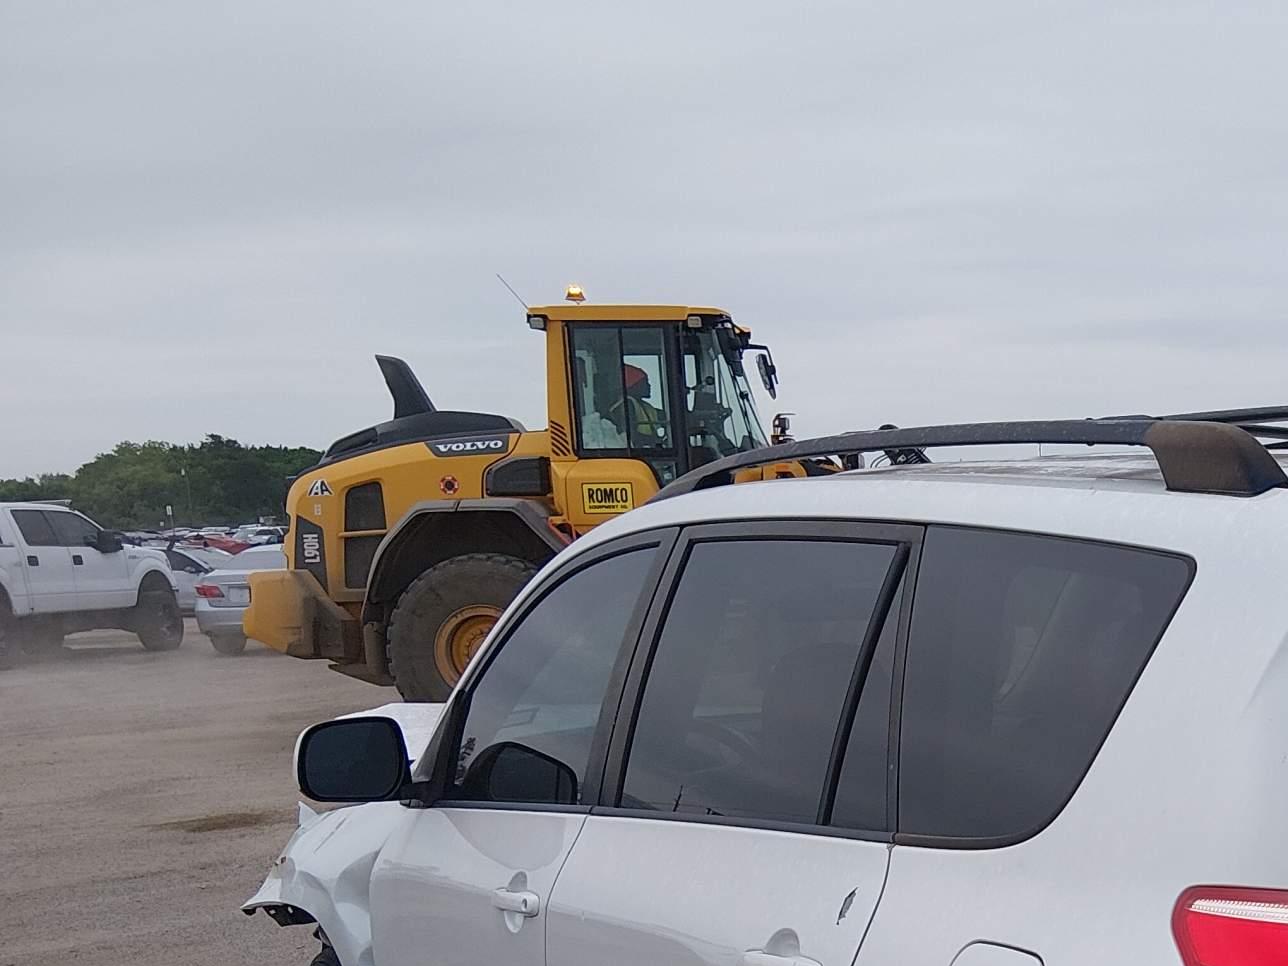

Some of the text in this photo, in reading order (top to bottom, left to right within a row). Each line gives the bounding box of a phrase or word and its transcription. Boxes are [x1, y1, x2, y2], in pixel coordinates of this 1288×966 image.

[434, 440, 503, 452] VOLVO
[587, 487, 628, 504] ROMCO
[302, 533, 321, 564] L90H
